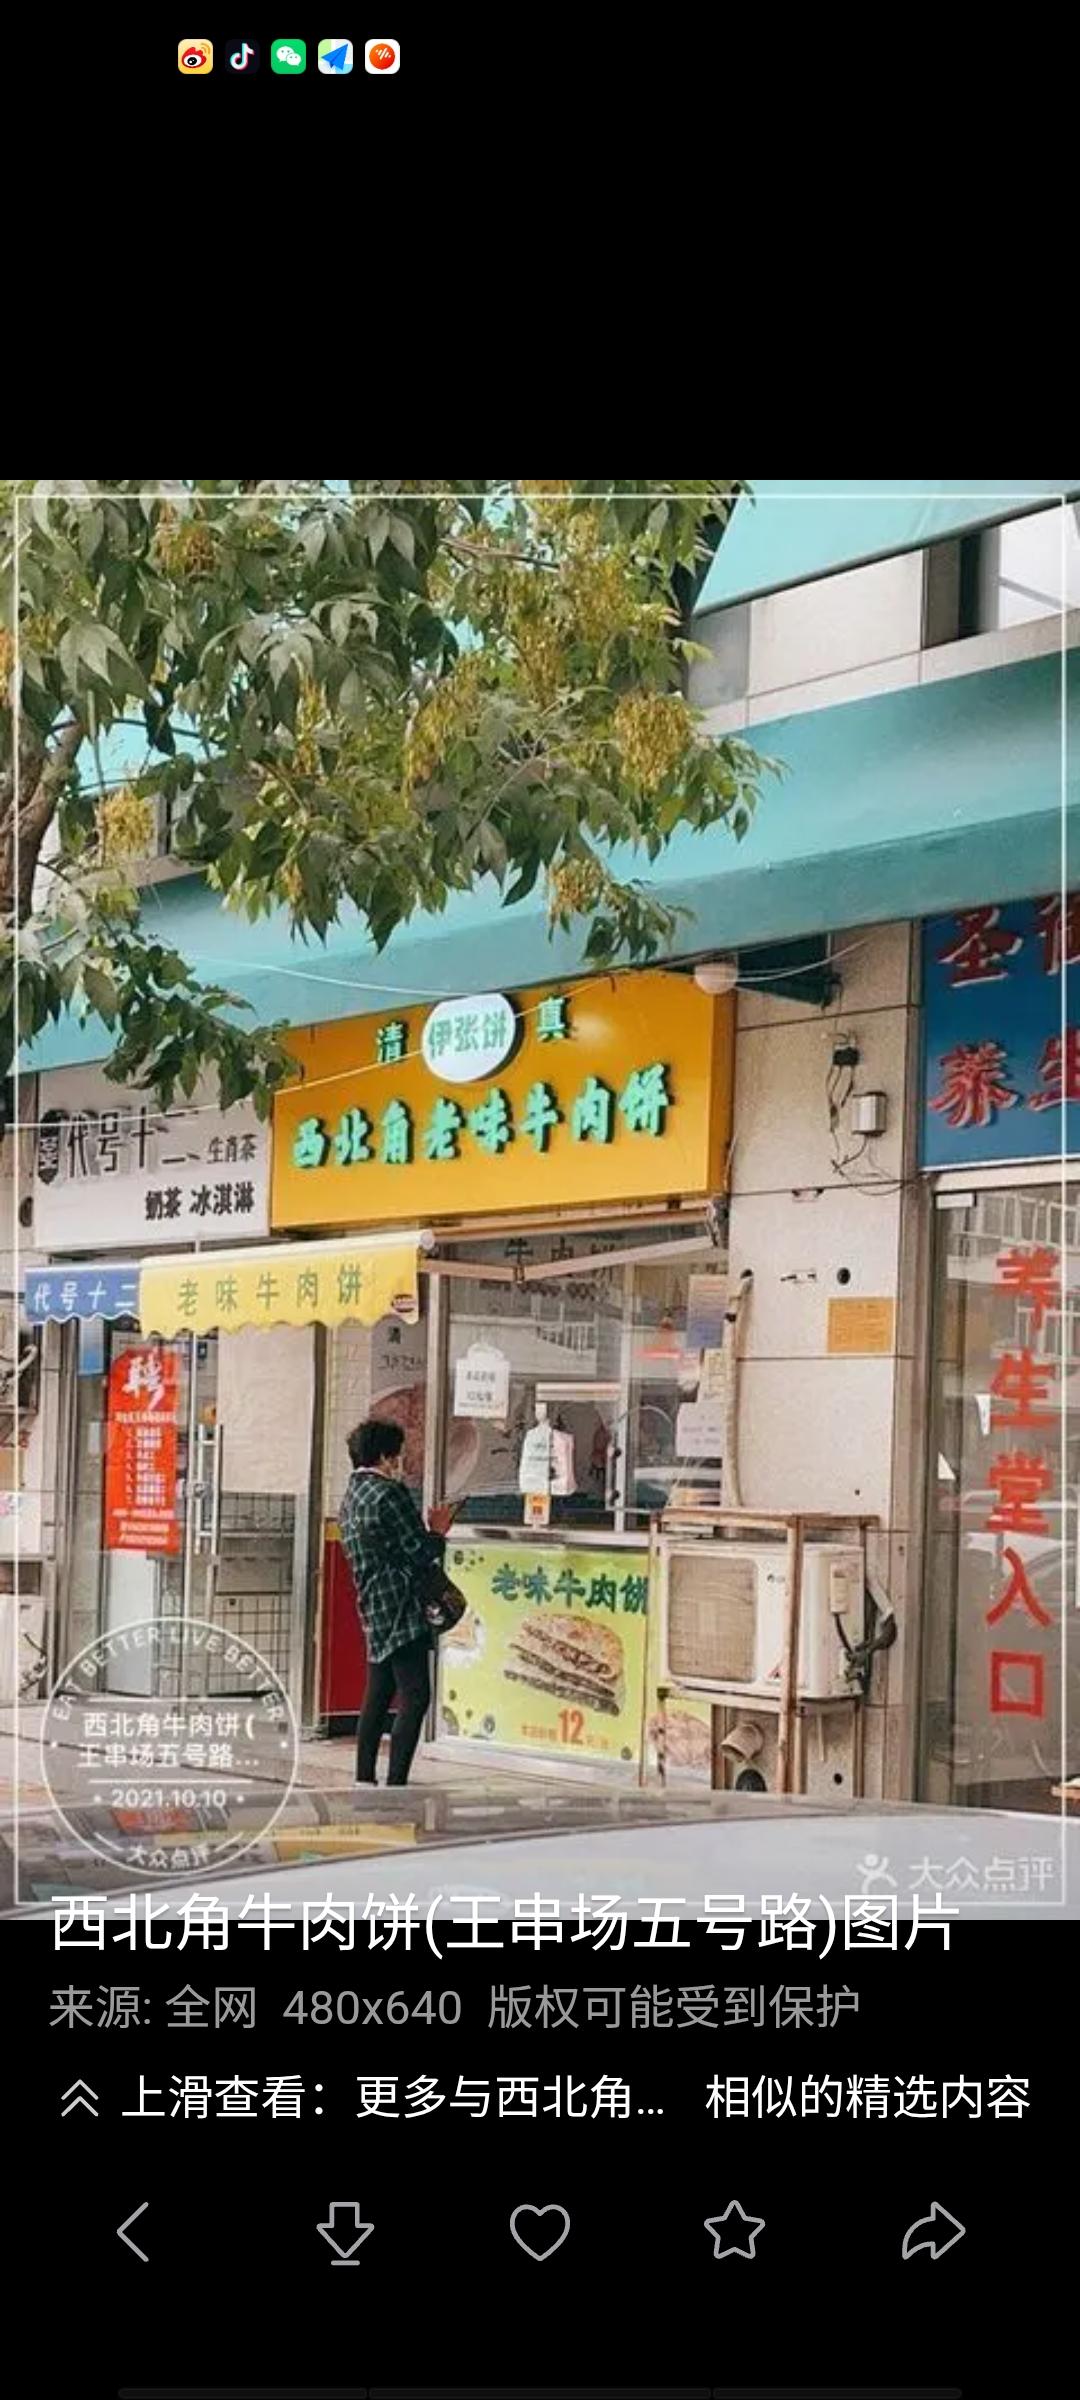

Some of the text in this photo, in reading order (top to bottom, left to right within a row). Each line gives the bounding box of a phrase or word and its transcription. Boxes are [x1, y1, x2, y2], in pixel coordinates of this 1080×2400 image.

[376, 996, 568, 1062] 清 伊张饼 真
[293, 1061, 672, 1168] 西北角老味牛肉饼
[145, 1182, 255, 1221] 奶茶 冰淇淋
[33, 1280, 137, 1312] 代号十二
[178, 1265, 361, 1315] 老味牛肉饼
[985, 1244, 1062, 1717] 养生堂入口
[558, 1708, 585, 1746] 12
